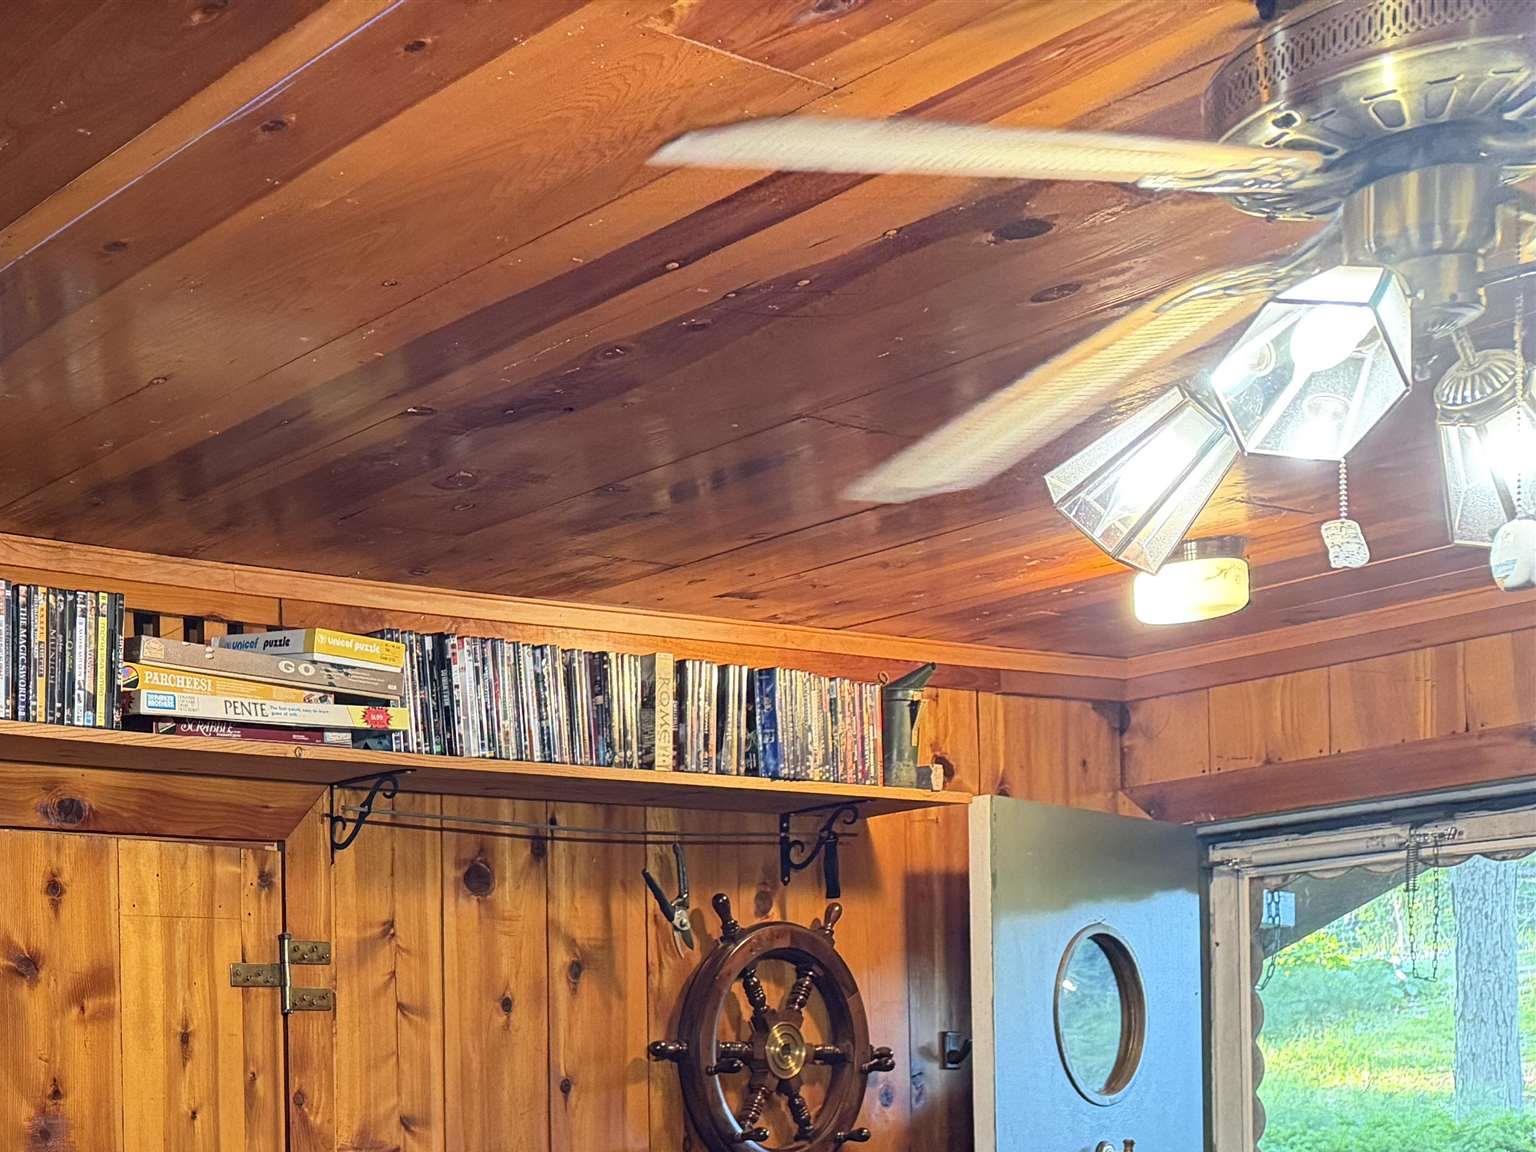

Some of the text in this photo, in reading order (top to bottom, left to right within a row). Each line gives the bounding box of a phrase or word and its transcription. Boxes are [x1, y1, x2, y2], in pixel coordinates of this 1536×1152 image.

[19, 628, 28, 663] MAGIC
[263, 637, 290, 650] puzzle
[18, 664, 27, 701] SWORD
[144, 671, 212, 692] PARCHEESI
[224, 699, 269, 718] PENTE
